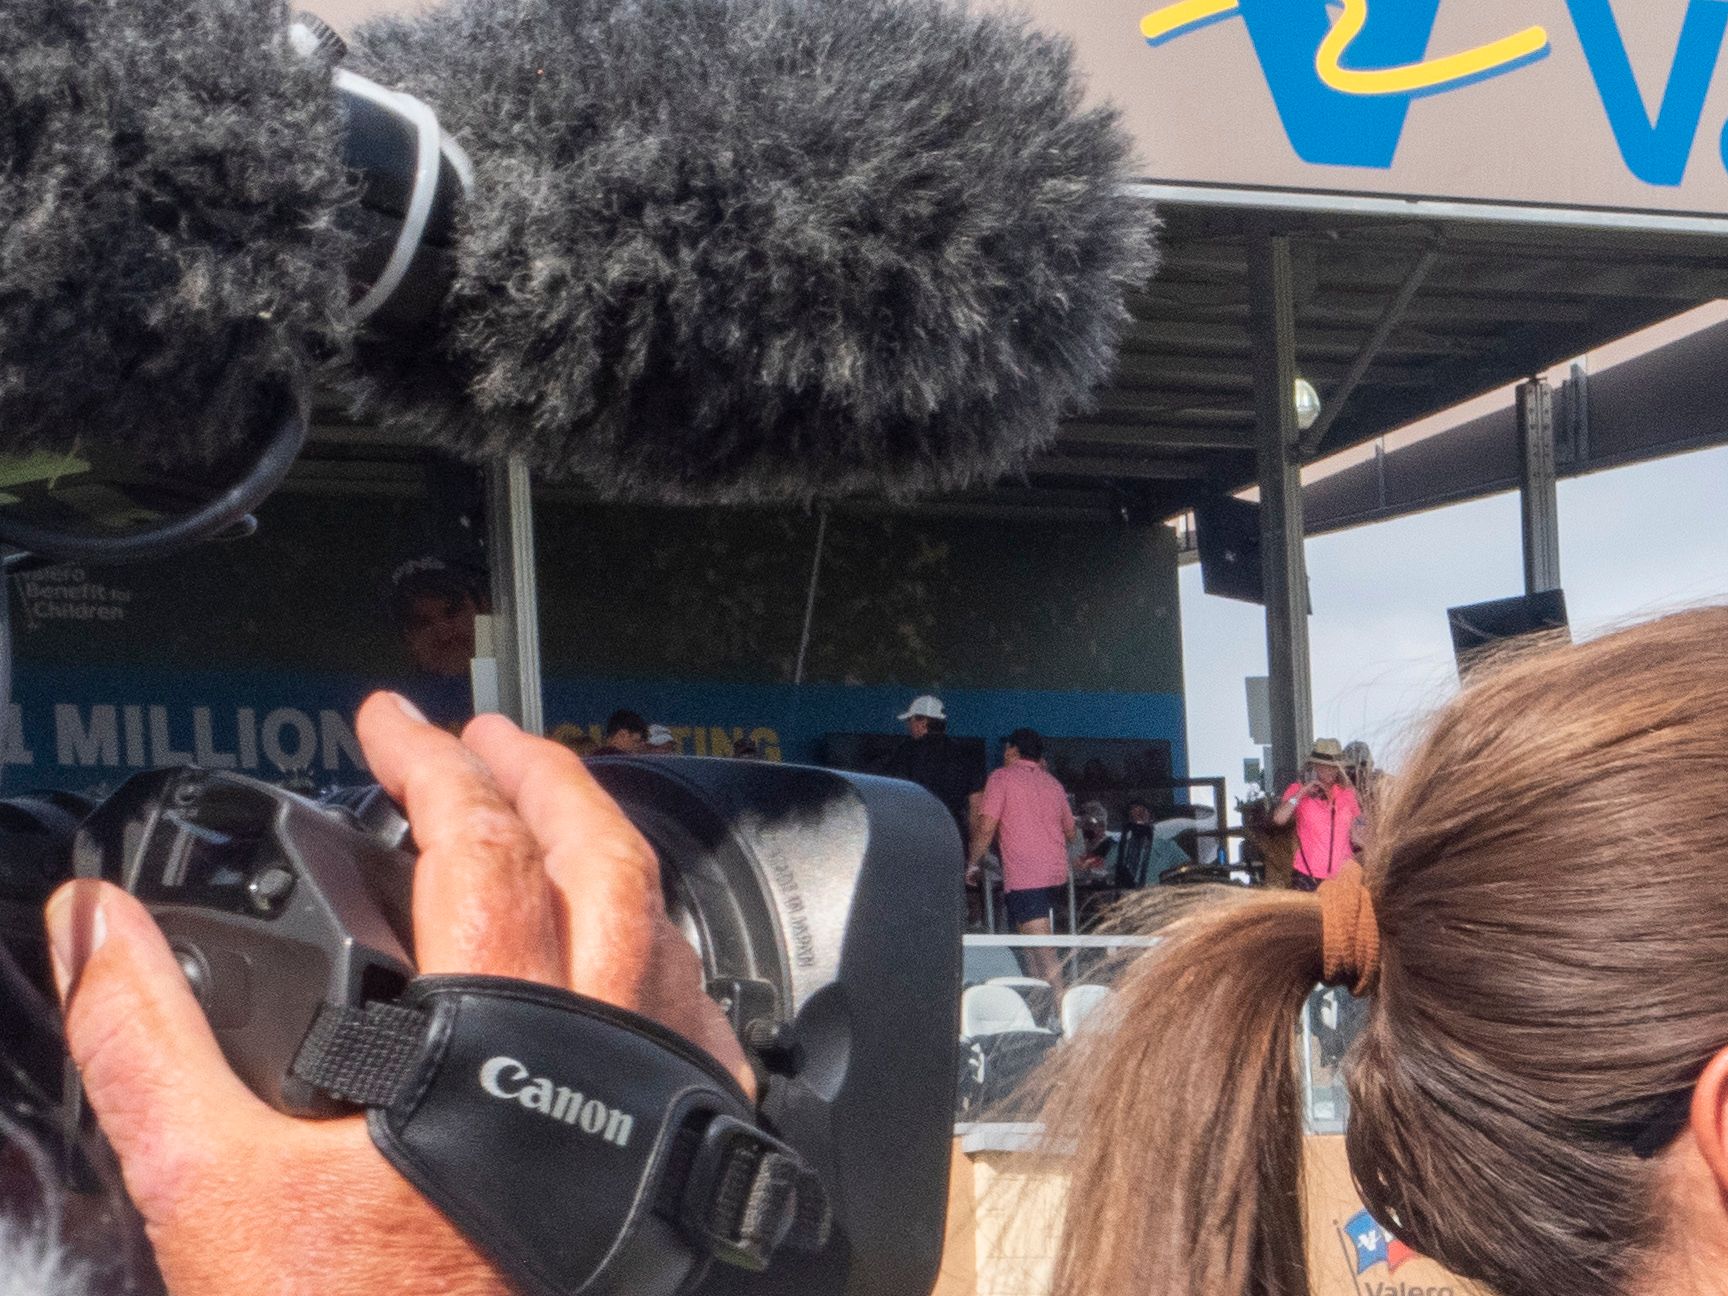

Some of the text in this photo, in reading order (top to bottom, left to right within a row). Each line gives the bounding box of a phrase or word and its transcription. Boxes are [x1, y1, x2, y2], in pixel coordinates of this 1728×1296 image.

[33, 601, 126, 620] Children
[55, 703, 373, 770] MILLION
[479, 1056, 633, 1148] Canon
